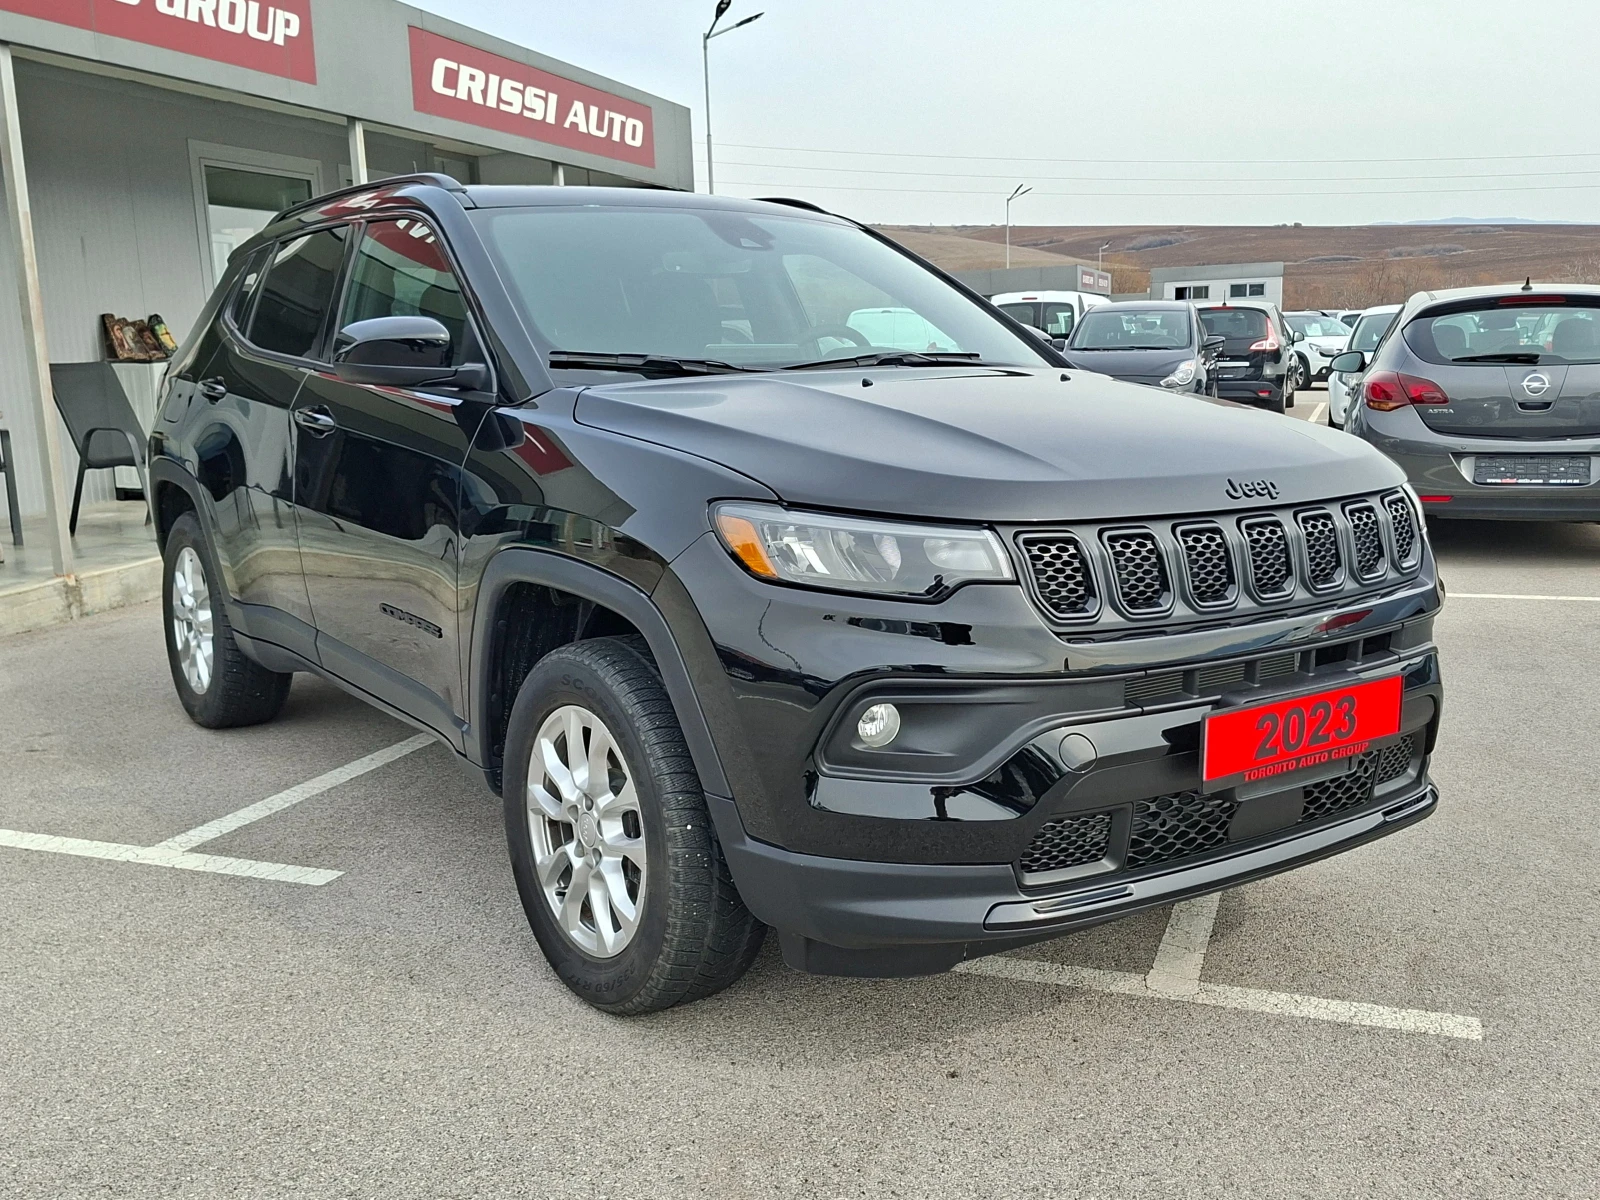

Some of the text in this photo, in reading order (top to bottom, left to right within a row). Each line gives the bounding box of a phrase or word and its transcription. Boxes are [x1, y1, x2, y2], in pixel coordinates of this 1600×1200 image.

[431, 57, 644, 148] CRISSI AUTO
[1225, 478, 1280, 500] Jeep
[1253, 695, 1358, 761] 2023
[1243, 741, 1371, 782] TORONTO AUTO GROUP
